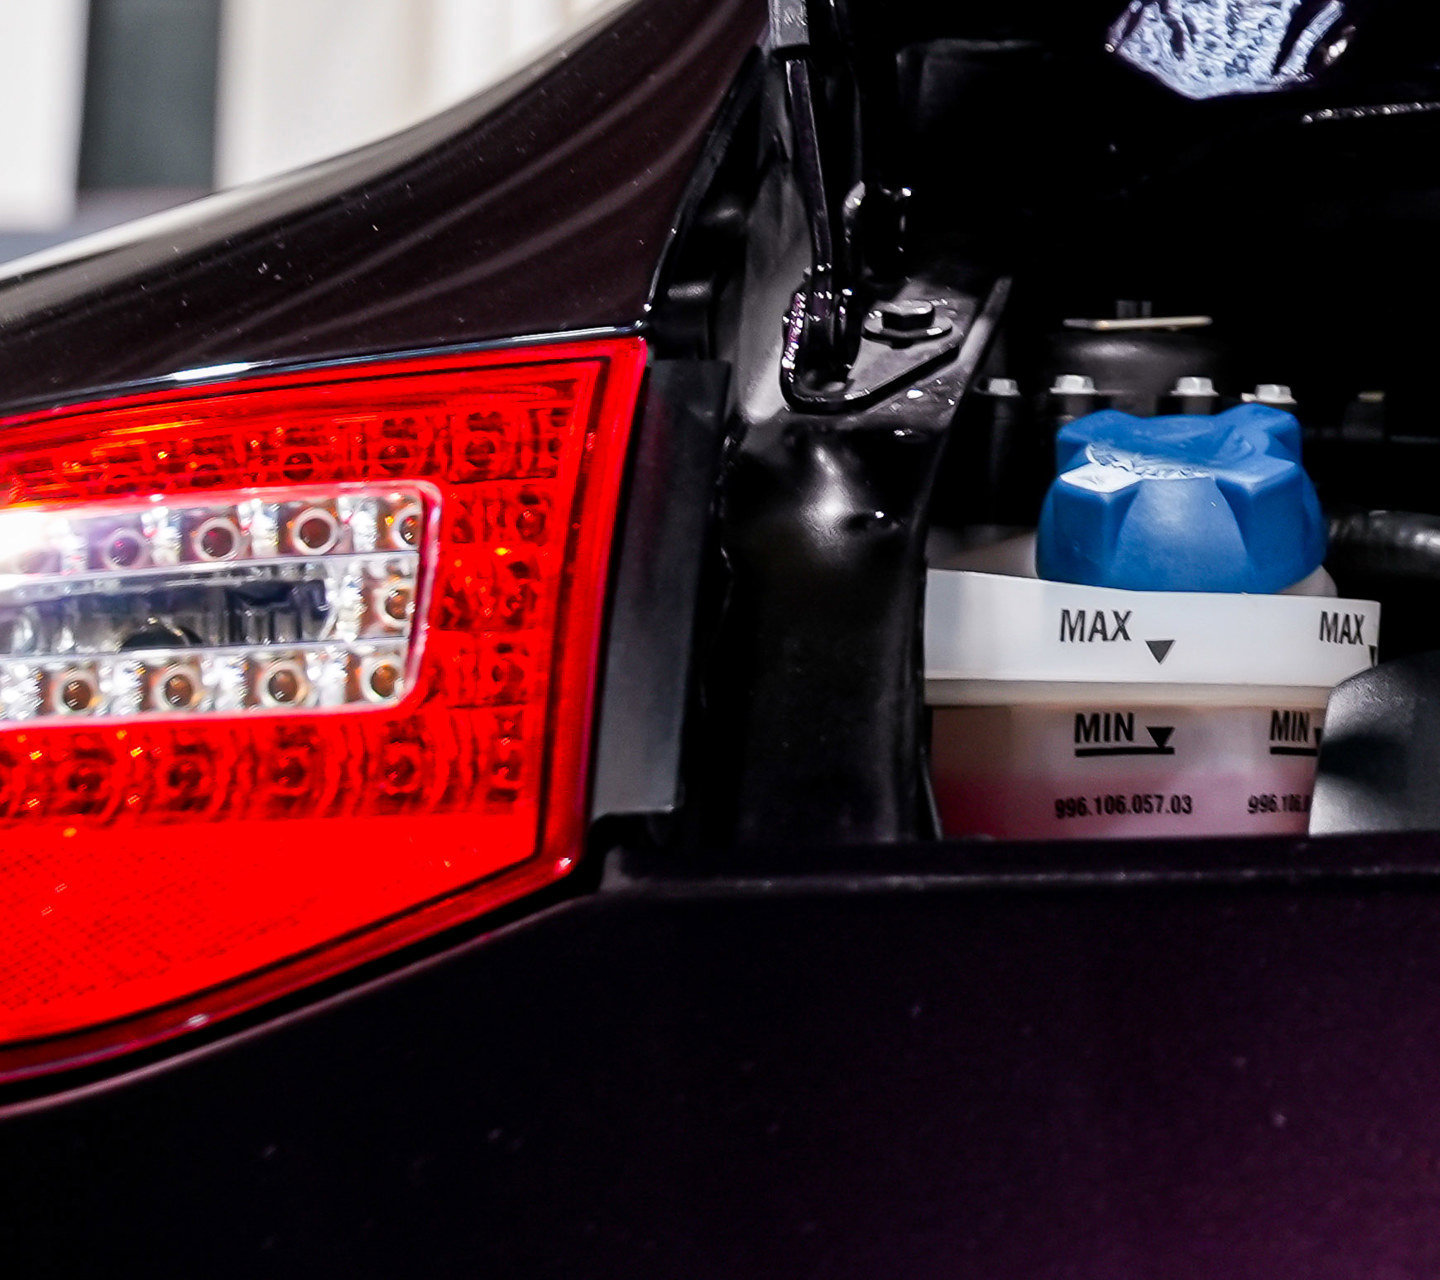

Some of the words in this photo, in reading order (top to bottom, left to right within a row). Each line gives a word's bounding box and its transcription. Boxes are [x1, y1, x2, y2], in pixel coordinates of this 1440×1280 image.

[1060, 609, 1131, 642] MAX
[1320, 611, 1364, 645] MAX
[1074, 712, 1134, 744] MIN
[1270, 710, 1310, 743] MIN
[1055, 795, 1193, 819] 996.106.057.03
